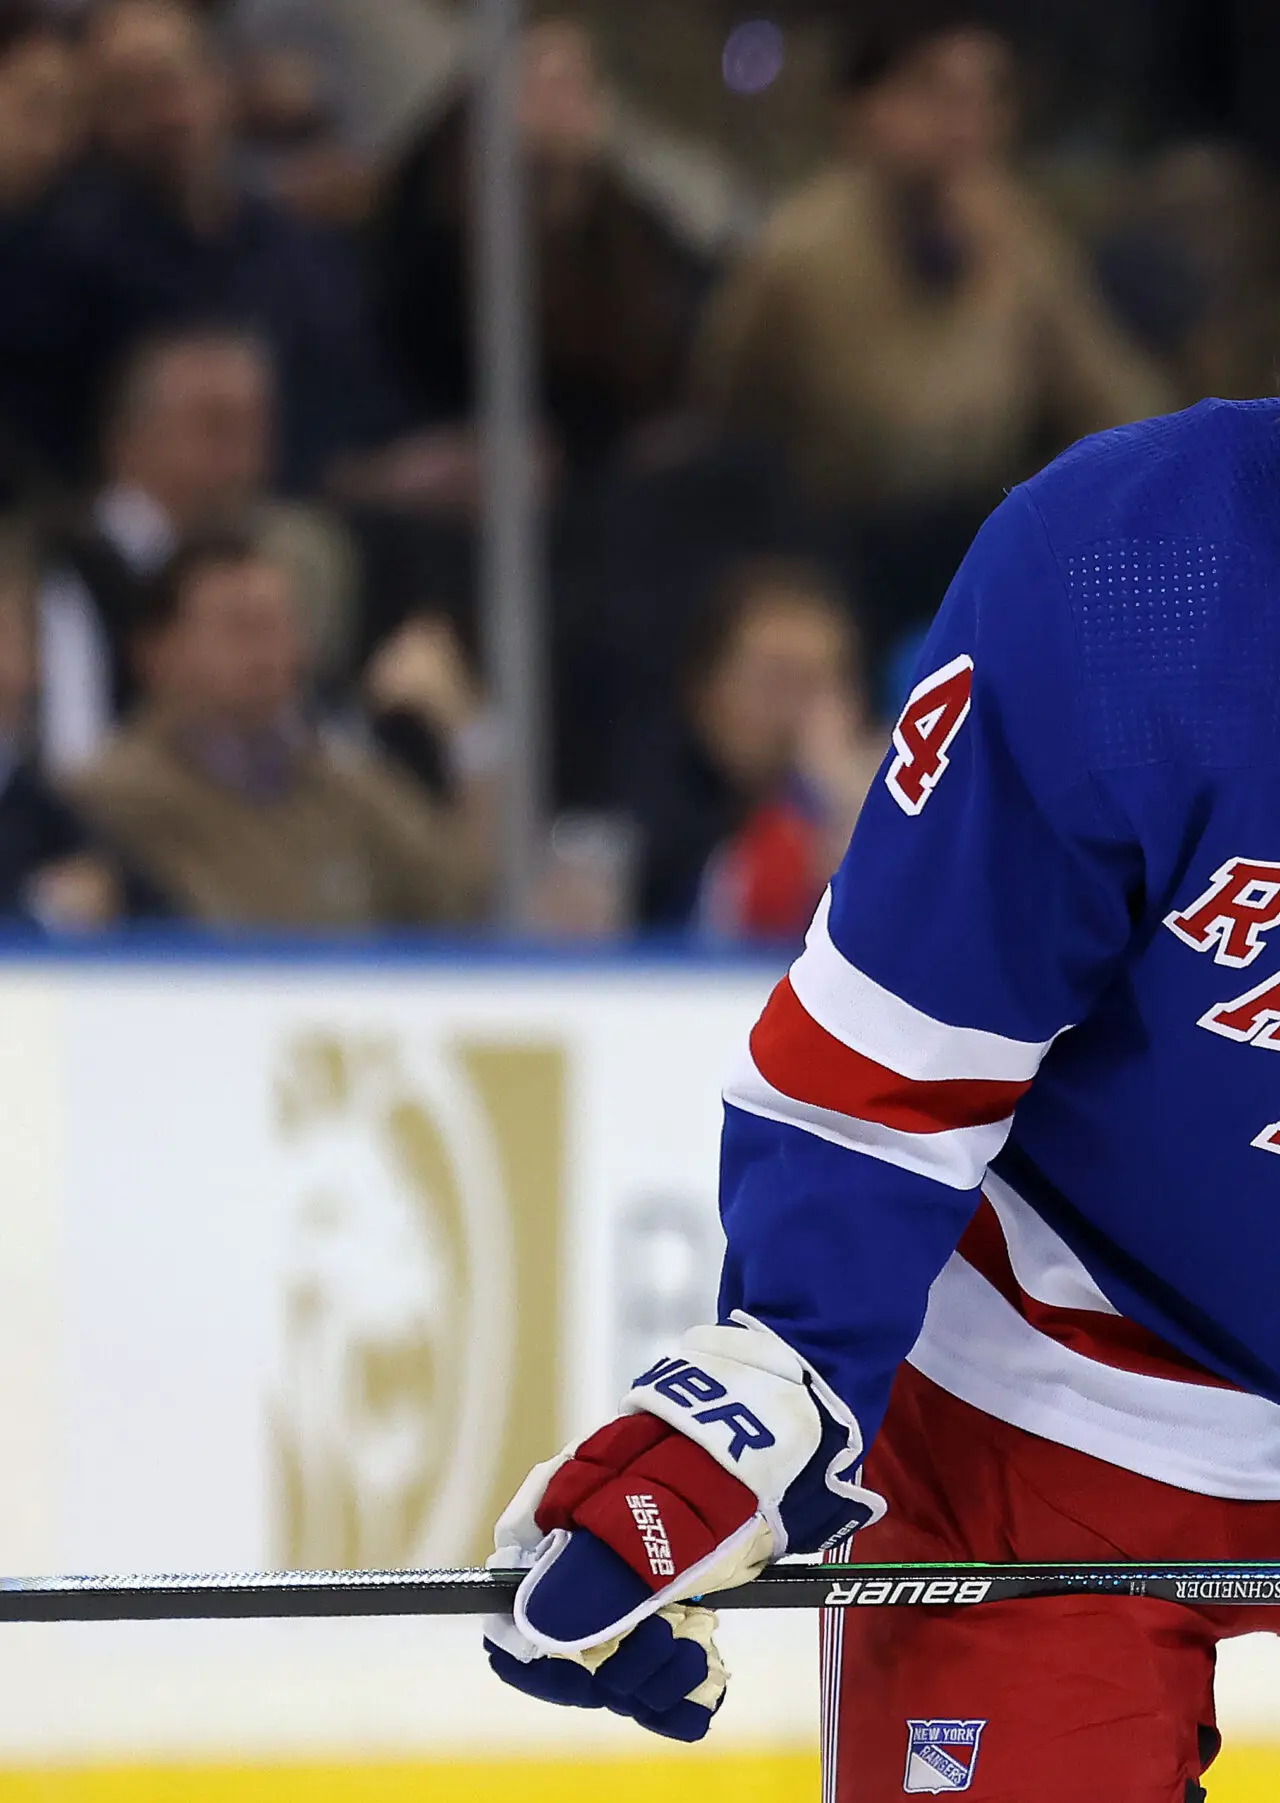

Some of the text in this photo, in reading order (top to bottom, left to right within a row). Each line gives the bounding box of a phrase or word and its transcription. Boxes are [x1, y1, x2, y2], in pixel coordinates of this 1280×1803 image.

[884, 653, 975, 817] 4
[913, 1727, 975, 1741] NEW YORK
[919, 1744, 967, 1785] RANGERS
